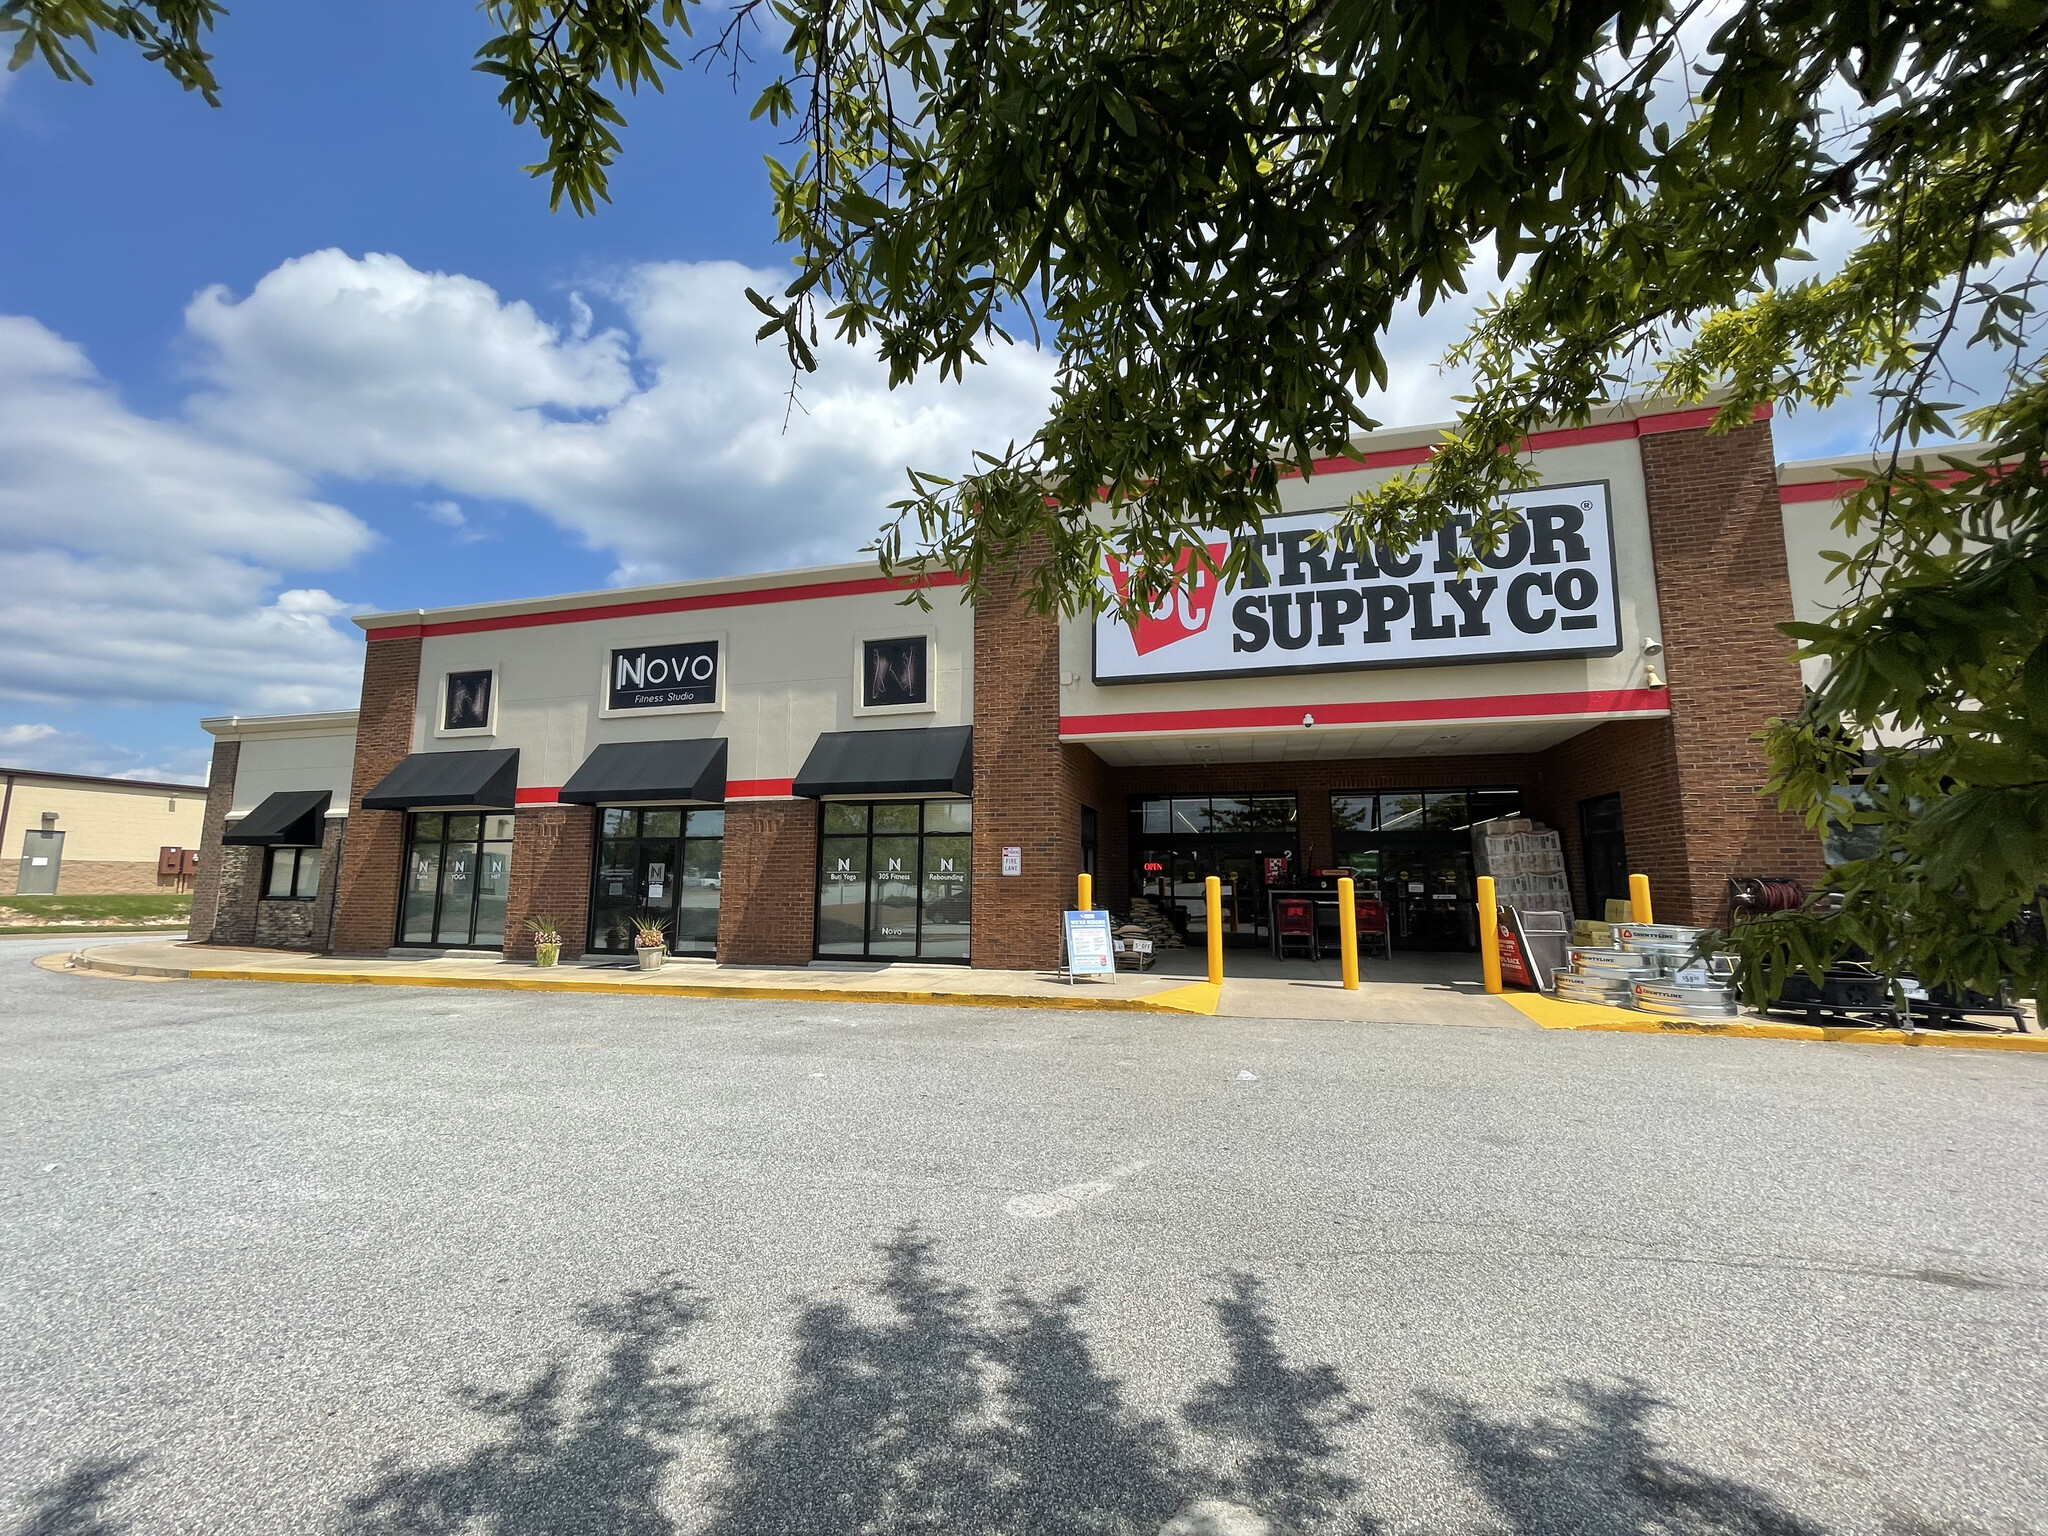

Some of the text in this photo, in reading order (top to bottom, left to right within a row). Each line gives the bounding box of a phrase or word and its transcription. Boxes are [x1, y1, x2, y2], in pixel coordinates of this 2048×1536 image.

[1231, 504, 1591, 590] TRACTOR
[1232, 576, 1498, 653] SUPPLY
[634, 691, 694, 704] Fitness Studio
[1283, 850, 1292, 861] 2
[1143, 862, 1163, 871] OPEN
[842, 873, 857, 881] Yoga
[929, 873, 964, 882] Rebounding
